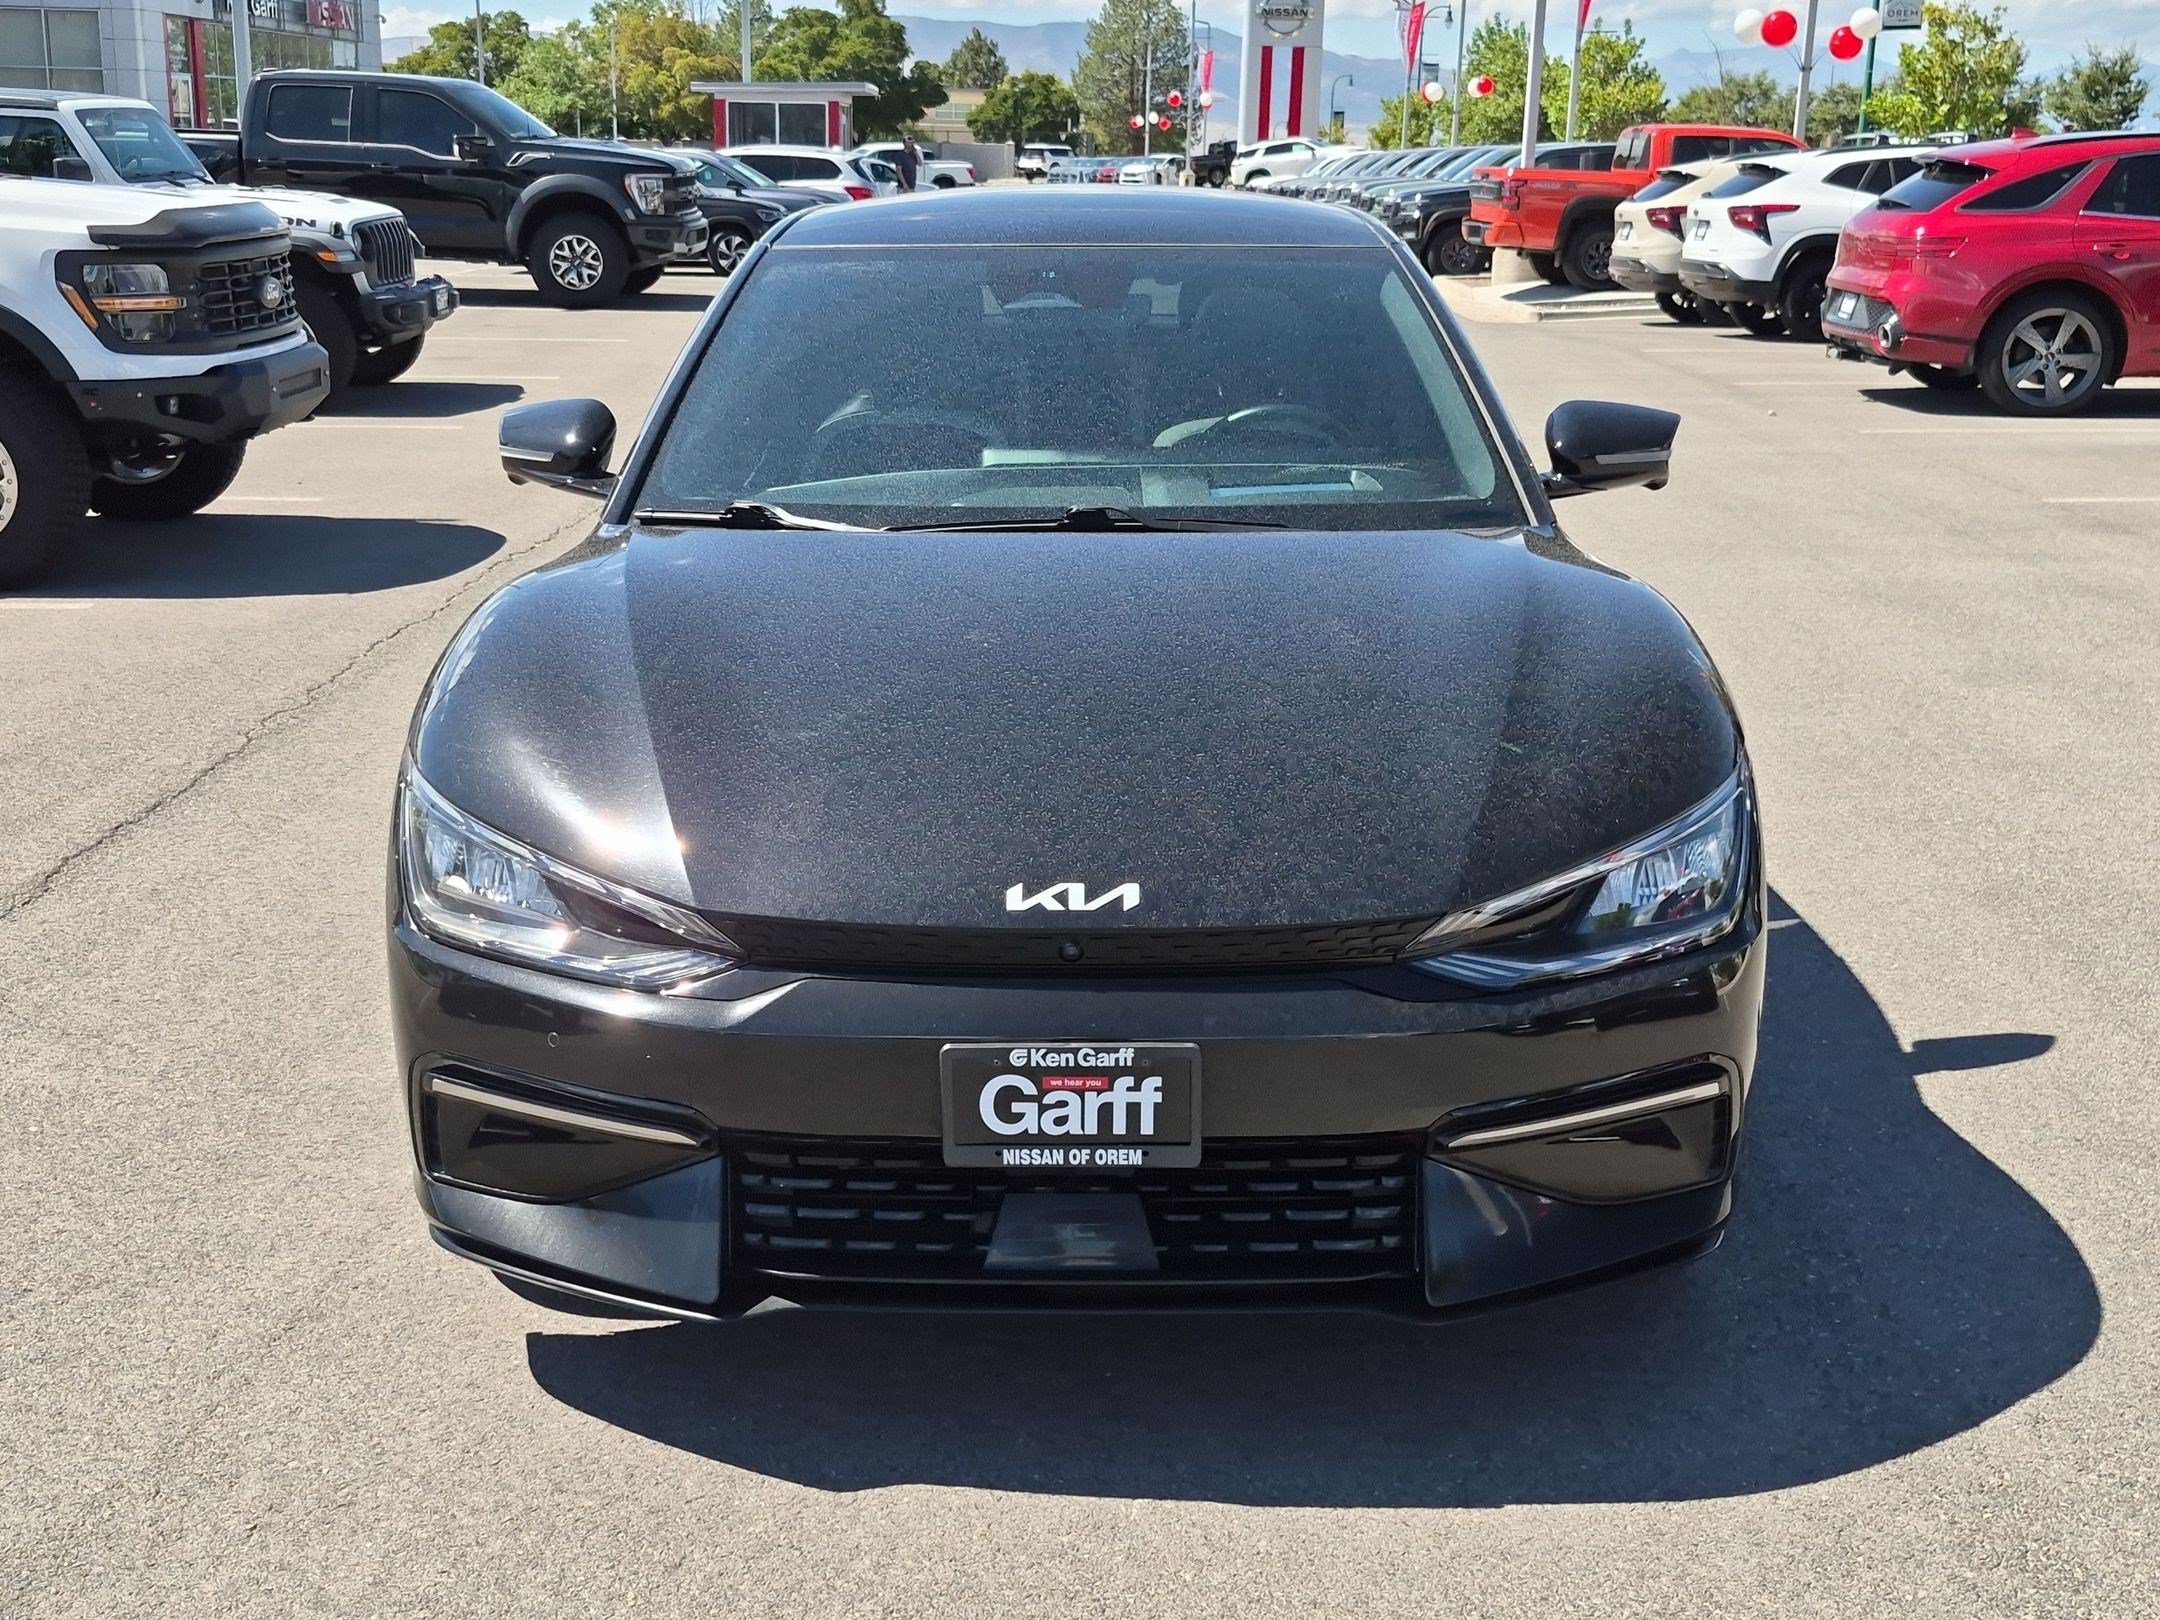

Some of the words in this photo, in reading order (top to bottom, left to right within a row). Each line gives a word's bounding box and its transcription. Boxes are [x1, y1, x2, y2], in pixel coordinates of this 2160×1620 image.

[1261, 8, 1308, 16] NISSAN
[1887, 9, 1918, 17] OREM
[1030, 1048, 1075, 1067] Ken
[1077, 1048, 1134, 1067] Garff
[1064, 1078, 1084, 1087] hear
[1086, 1080, 1102, 1089] you
[979, 1073, 1163, 1136] Garff
[1002, 1148, 1064, 1165] NISSAN
[1069, 1148, 1090, 1165] OF
[1095, 1148, 1143, 1165] OREM
